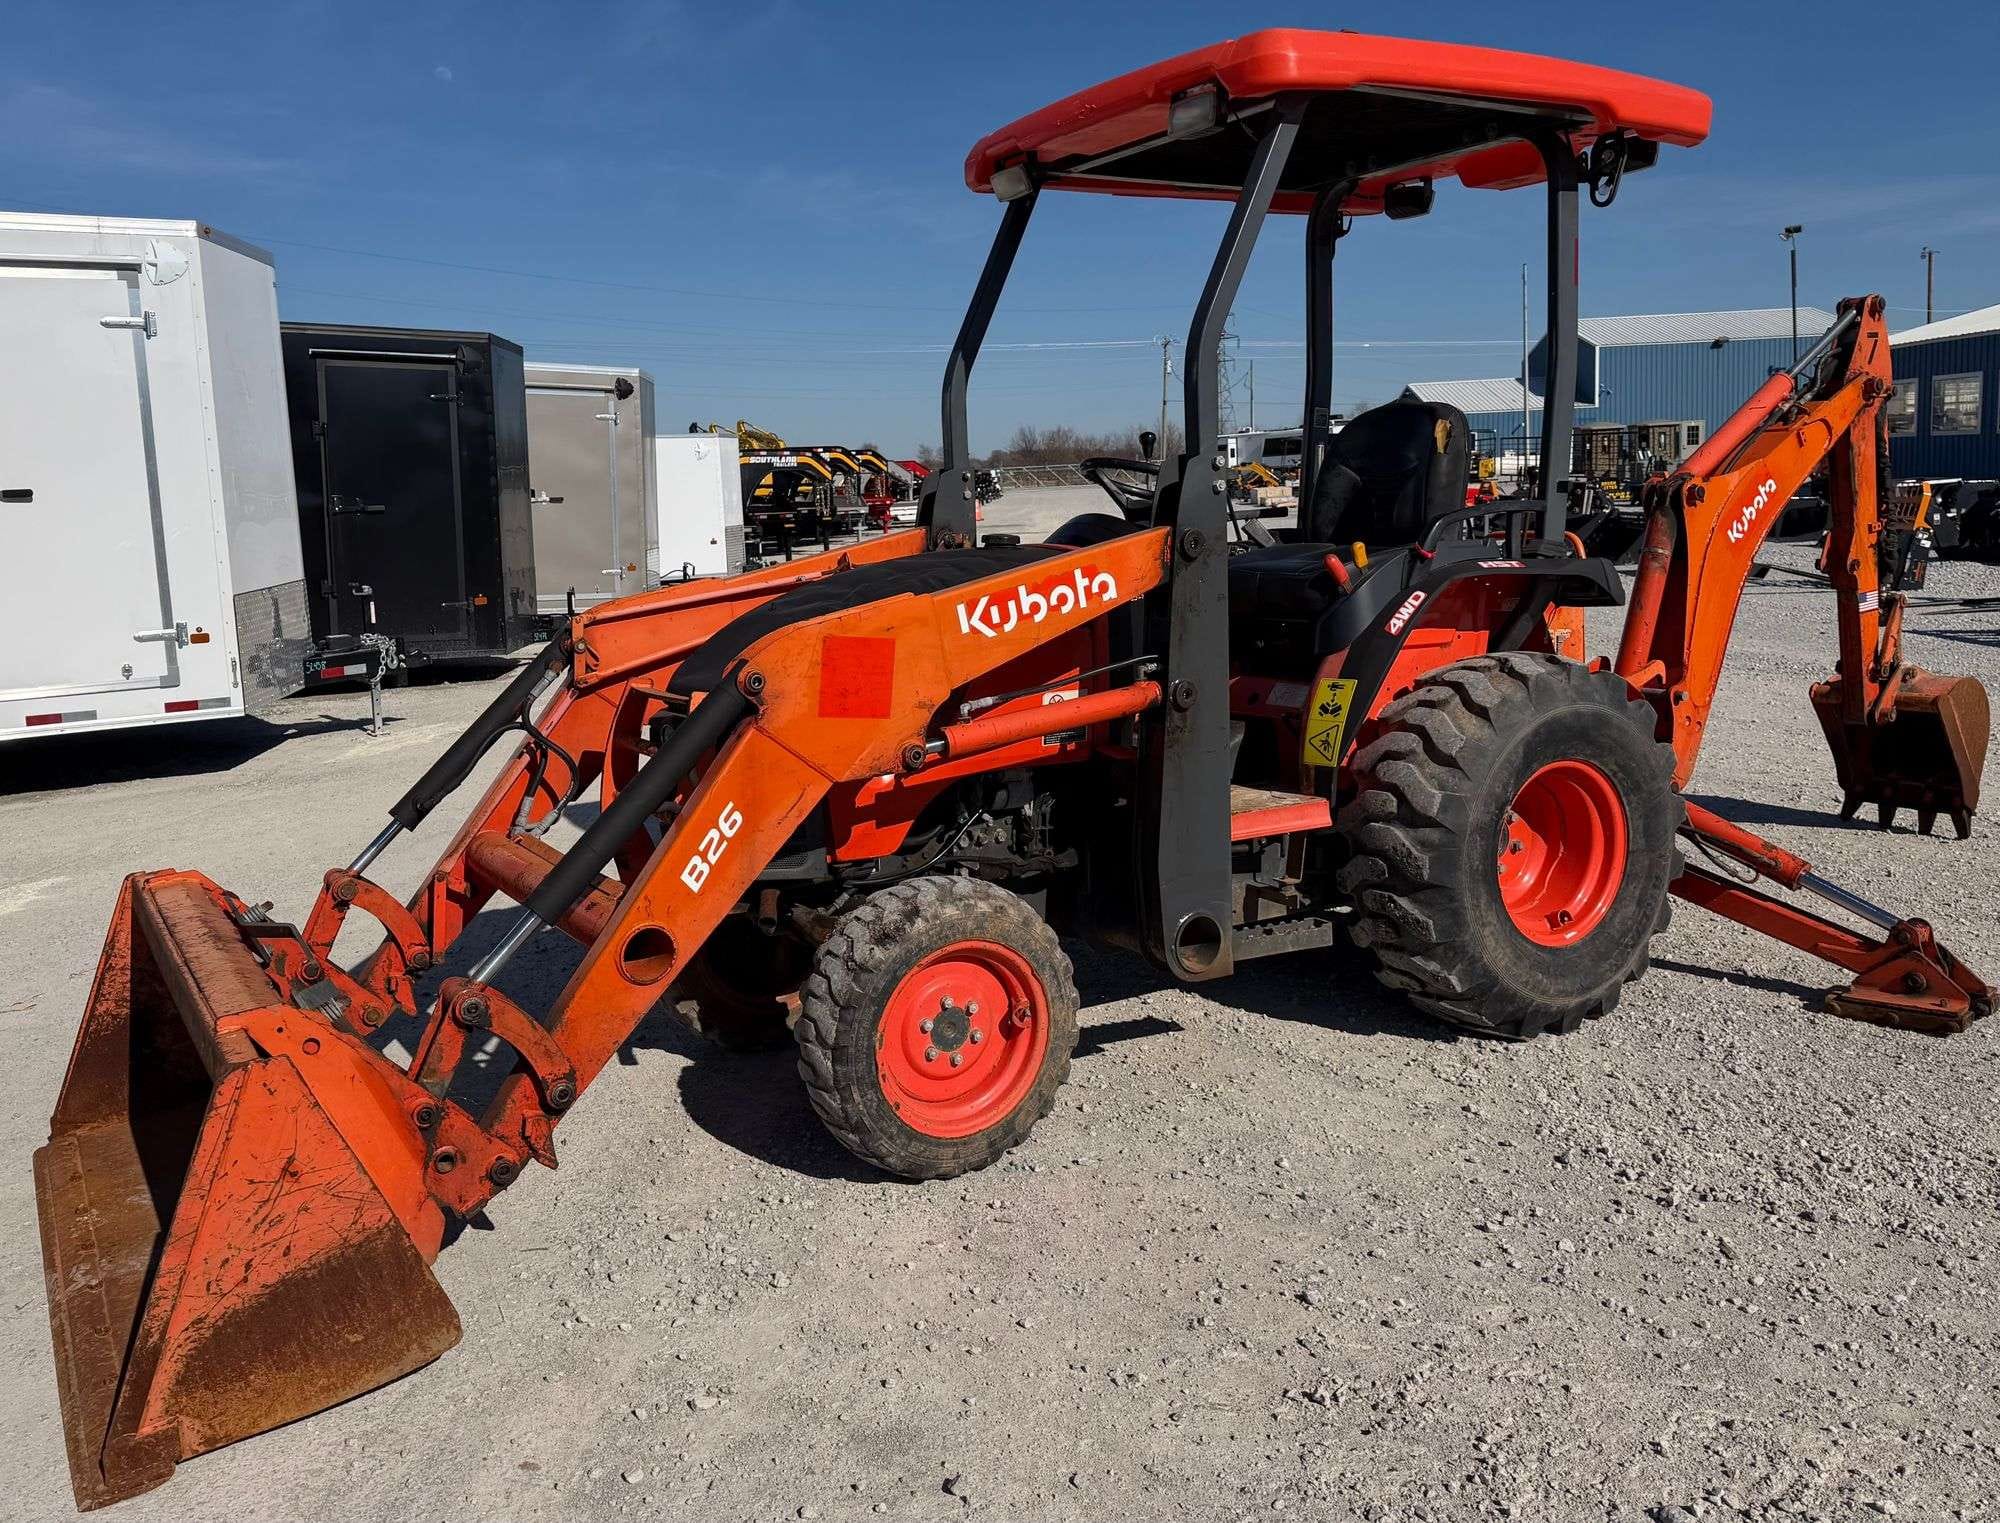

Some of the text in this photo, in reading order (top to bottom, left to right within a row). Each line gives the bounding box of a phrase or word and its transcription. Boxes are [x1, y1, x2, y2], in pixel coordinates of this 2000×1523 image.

[750, 456, 797, 464] SOUTHLAND
[1727, 479, 1777, 543] Kubota
[1478, 560, 1522, 569] HST
[956, 567, 1118, 638] Kubota
[1390, 590, 1426, 635] 4WD
[679, 800, 744, 894] B26
